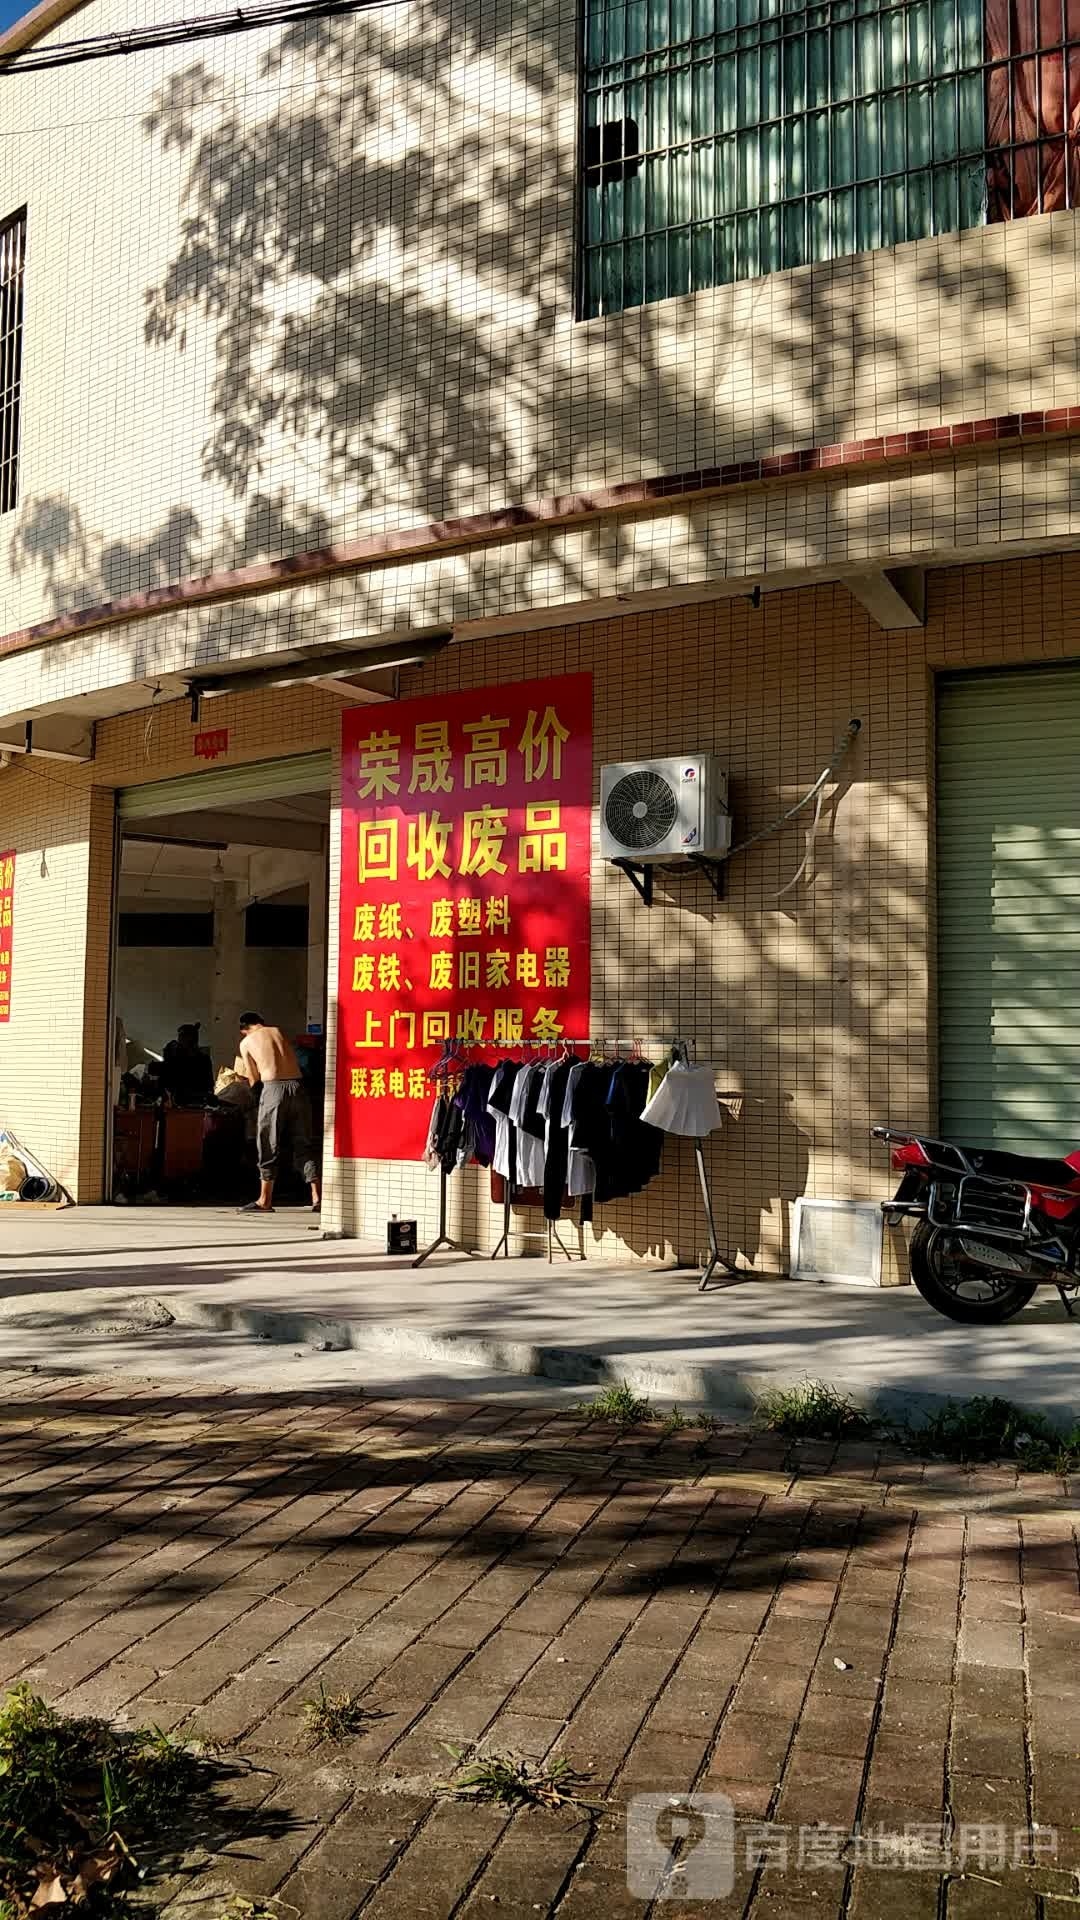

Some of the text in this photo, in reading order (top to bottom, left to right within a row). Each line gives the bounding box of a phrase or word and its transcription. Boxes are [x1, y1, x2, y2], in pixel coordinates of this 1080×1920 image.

[357, 706, 570, 800] 荣晟高价
[357, 800, 568, 883] 回收废品
[353, 895, 511, 941] 废纸、废塑料
[352, 947, 571, 992] 废铁、废旧家电器
[355, 1007, 564, 1049] 上门回收服务
